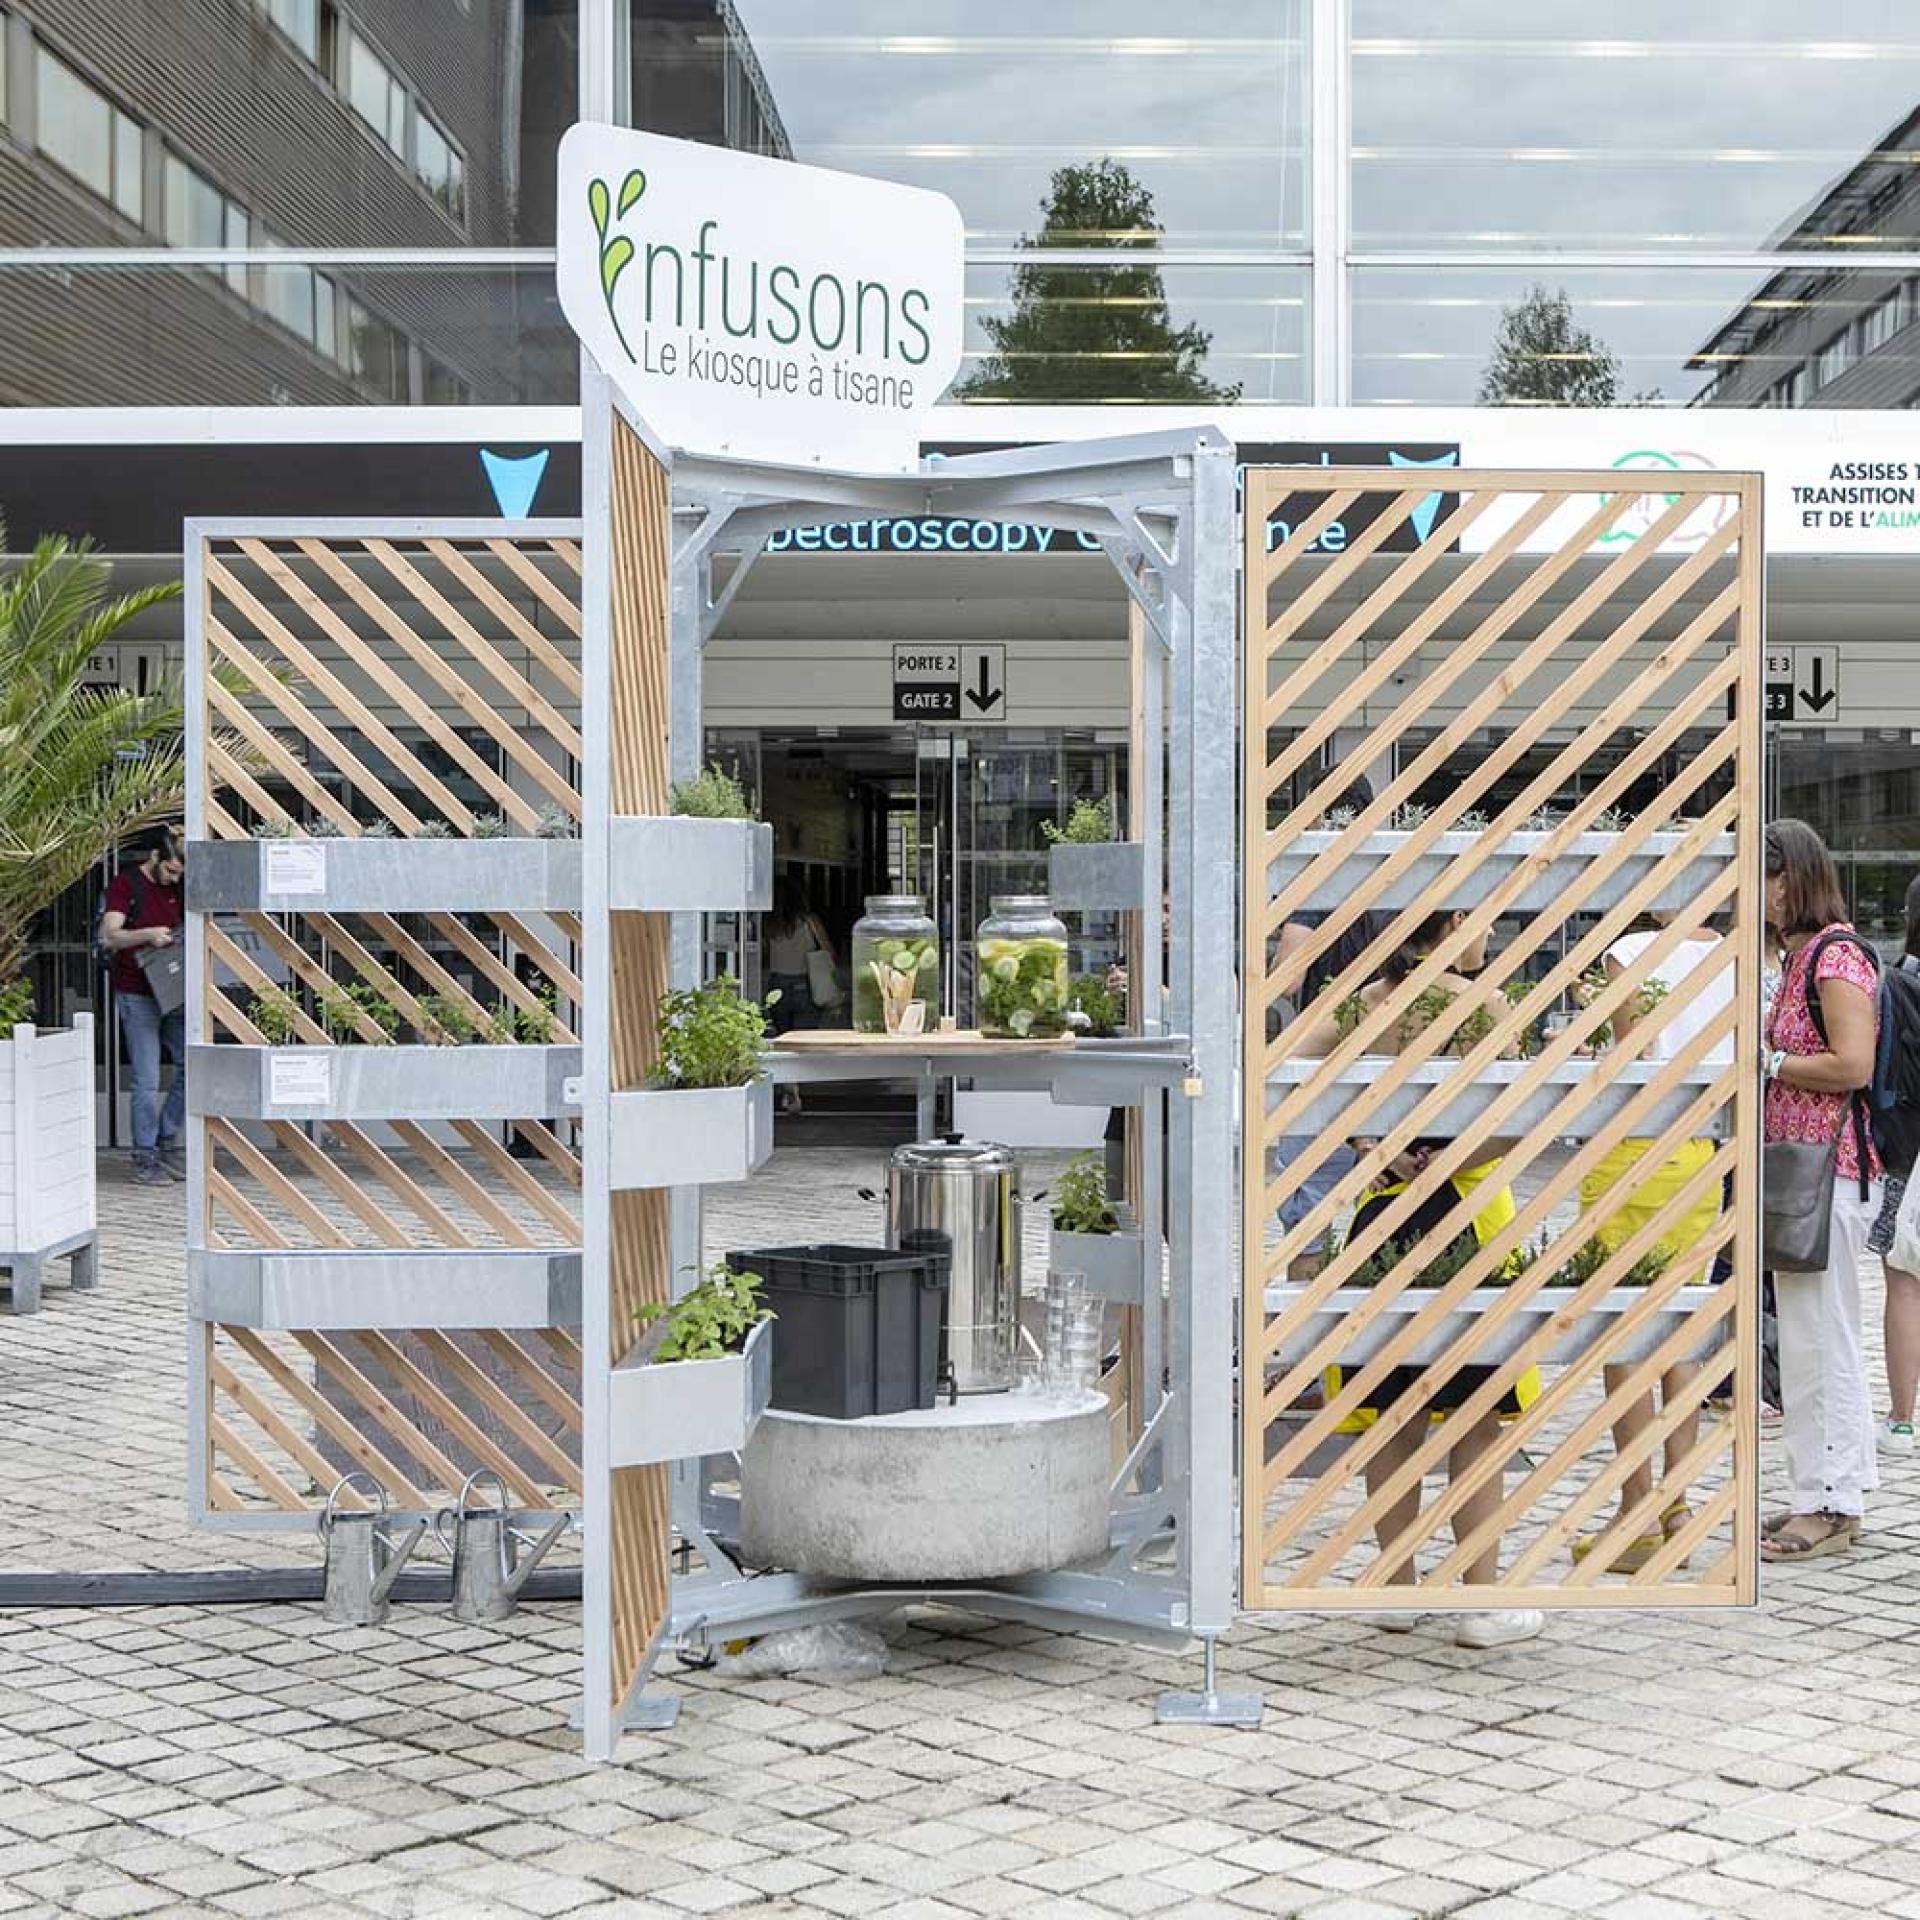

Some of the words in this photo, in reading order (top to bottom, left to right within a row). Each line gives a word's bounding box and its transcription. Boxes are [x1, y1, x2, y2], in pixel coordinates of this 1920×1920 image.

[644, 329, 677, 376] Le
[687, 335, 799, 399] kiosque
[808, 353, 823, 397] à
[833, 359, 914, 410] tisane
[1829, 462, 1908, 480] ASSISES
[1791, 486, 1915, 504] TRANSITION
[1802, 510, 1823, 528] ET
[1829, 510, 1854, 528] DE
[767, 519, 1055, 552] pectroscopy
[897, 656, 943, 671] PORTE
[947, 656, 957, 671] 2
[1781, 657, 1790, 671] 3
[901, 692, 940, 709] GATE
[944, 692, 953, 709] 2
[1777, 694, 1787, 710] 3
